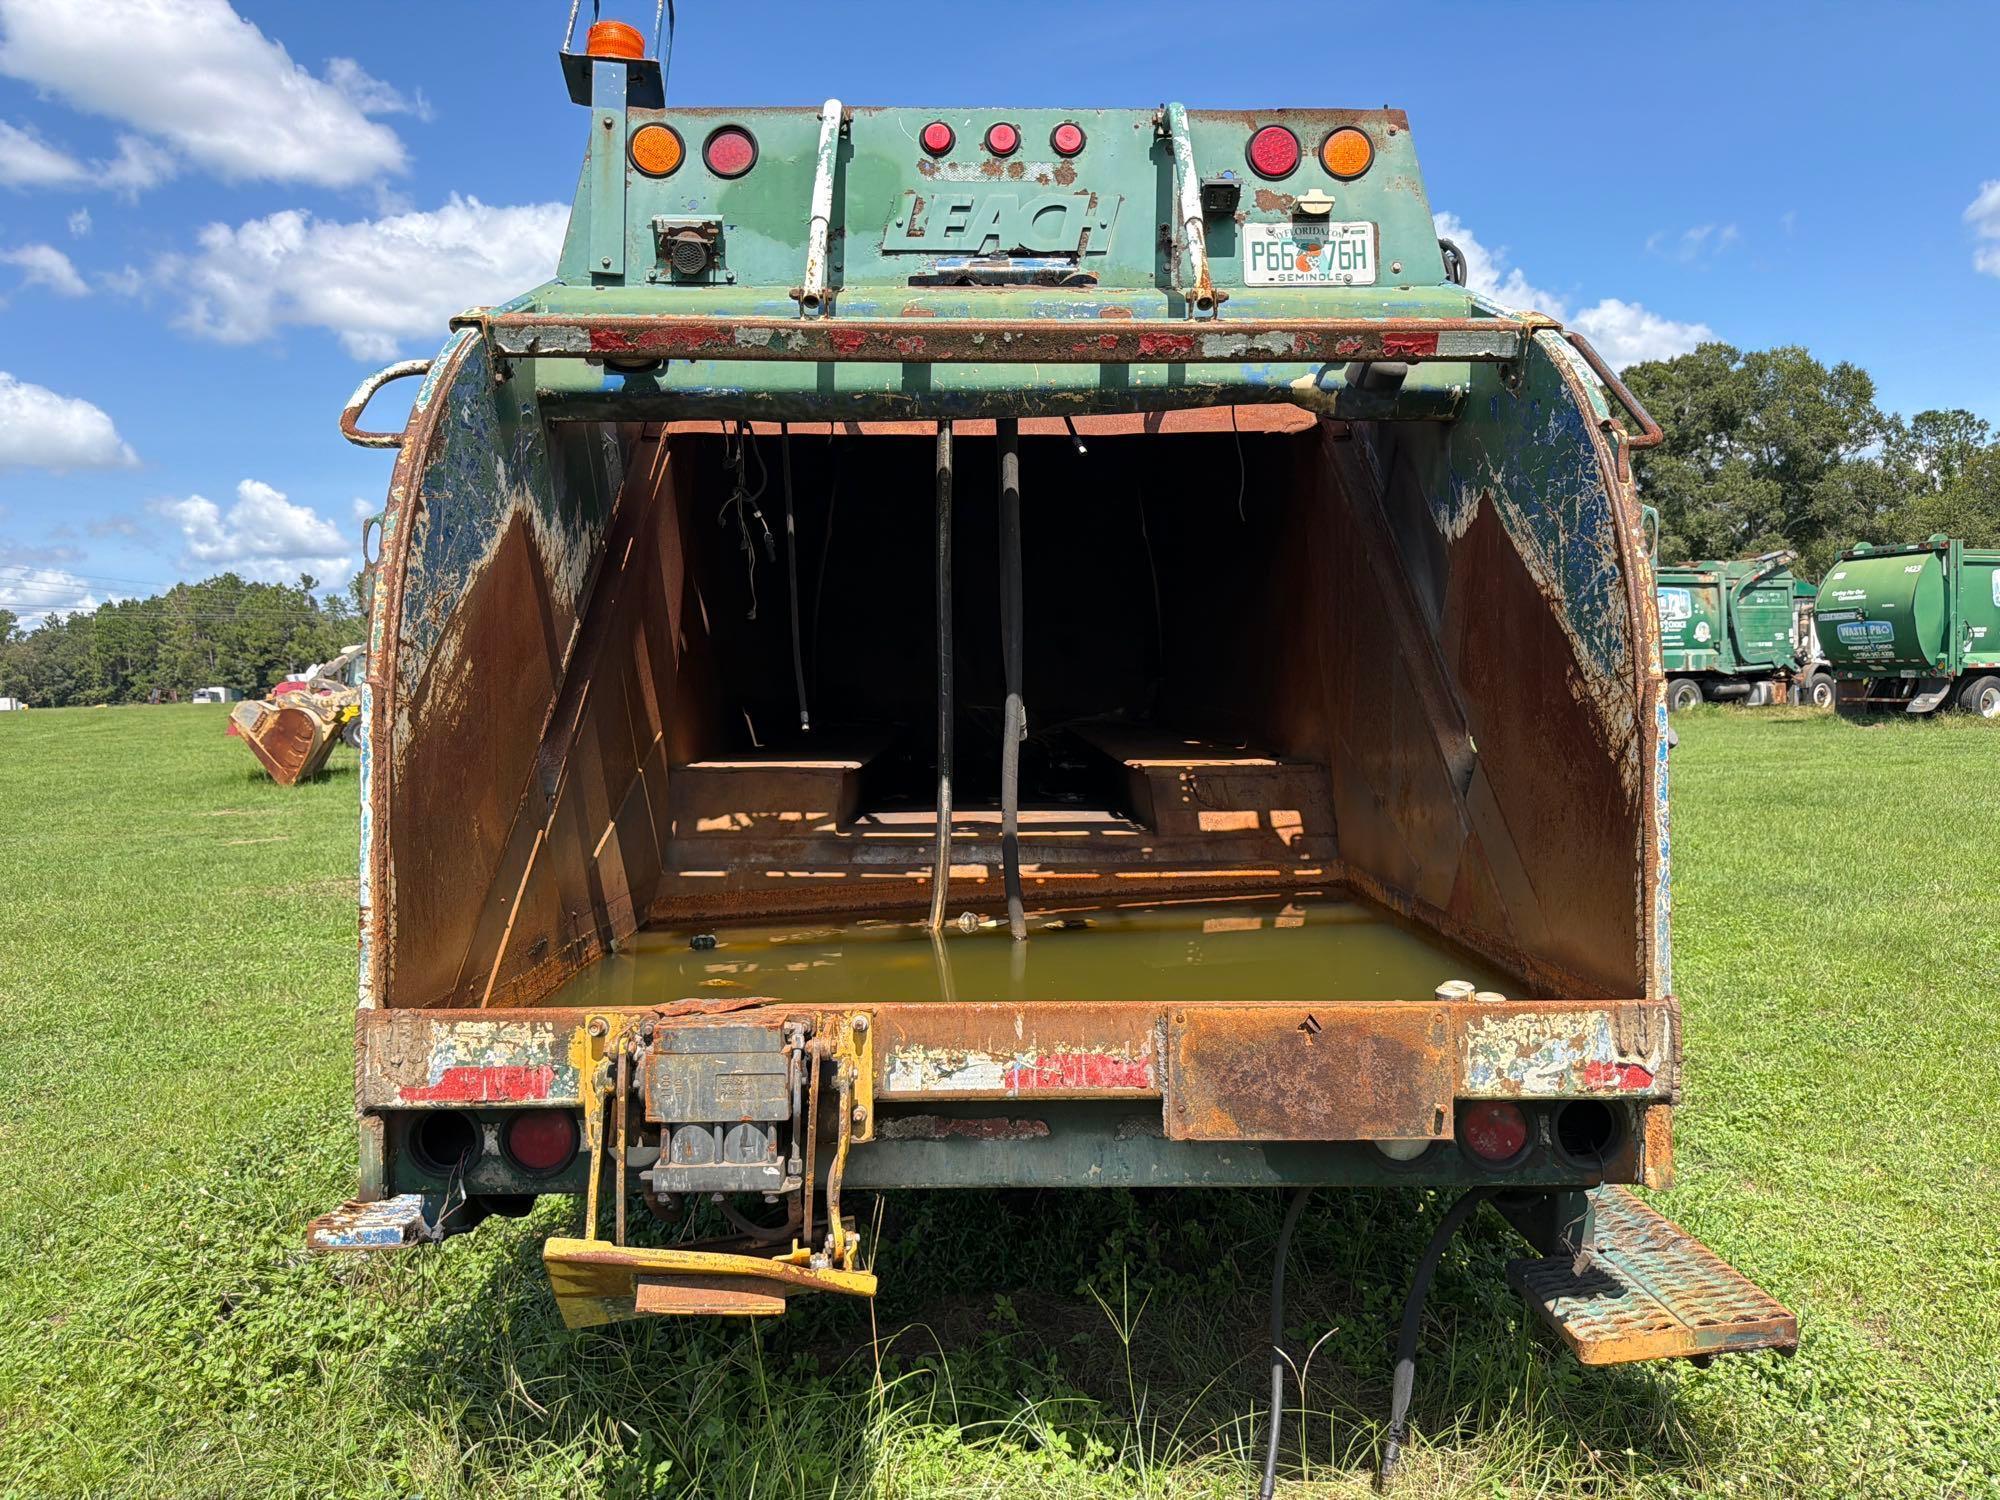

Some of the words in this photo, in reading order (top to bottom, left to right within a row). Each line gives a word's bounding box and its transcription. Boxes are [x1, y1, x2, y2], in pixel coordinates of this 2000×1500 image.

[882, 193, 1121, 256] LEACH
[1252, 241, 1294, 271] P66
[1323, 240, 1367, 270] 76H
[1278, 273, 1342, 282] SEMINOLE
[1840, 626, 1867, 637] WASTE
